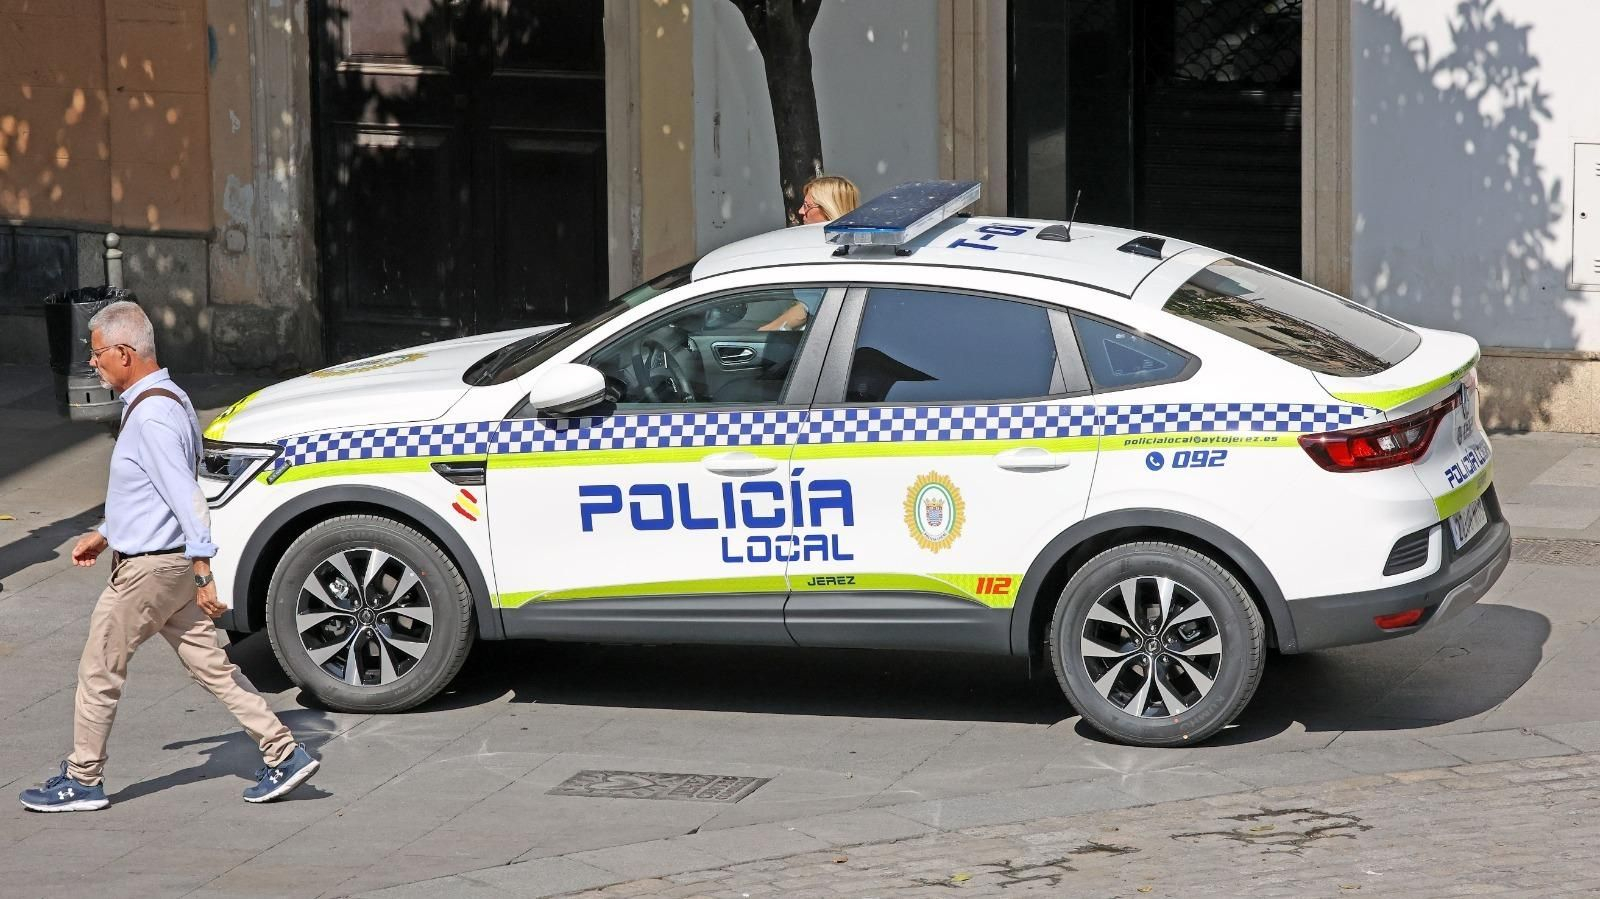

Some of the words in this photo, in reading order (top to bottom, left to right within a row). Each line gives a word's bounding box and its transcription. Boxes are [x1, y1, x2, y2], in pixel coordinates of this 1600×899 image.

[1124, 435, 1278, 446] policialocal@aytojerez.es
[1172, 450, 1228, 468] 092
[579, 467, 854, 532] POLICÍA
[721, 534, 854, 563] LOCAL
[807, 575, 856, 586] JEREZ
[976, 577, 1011, 594] 112
